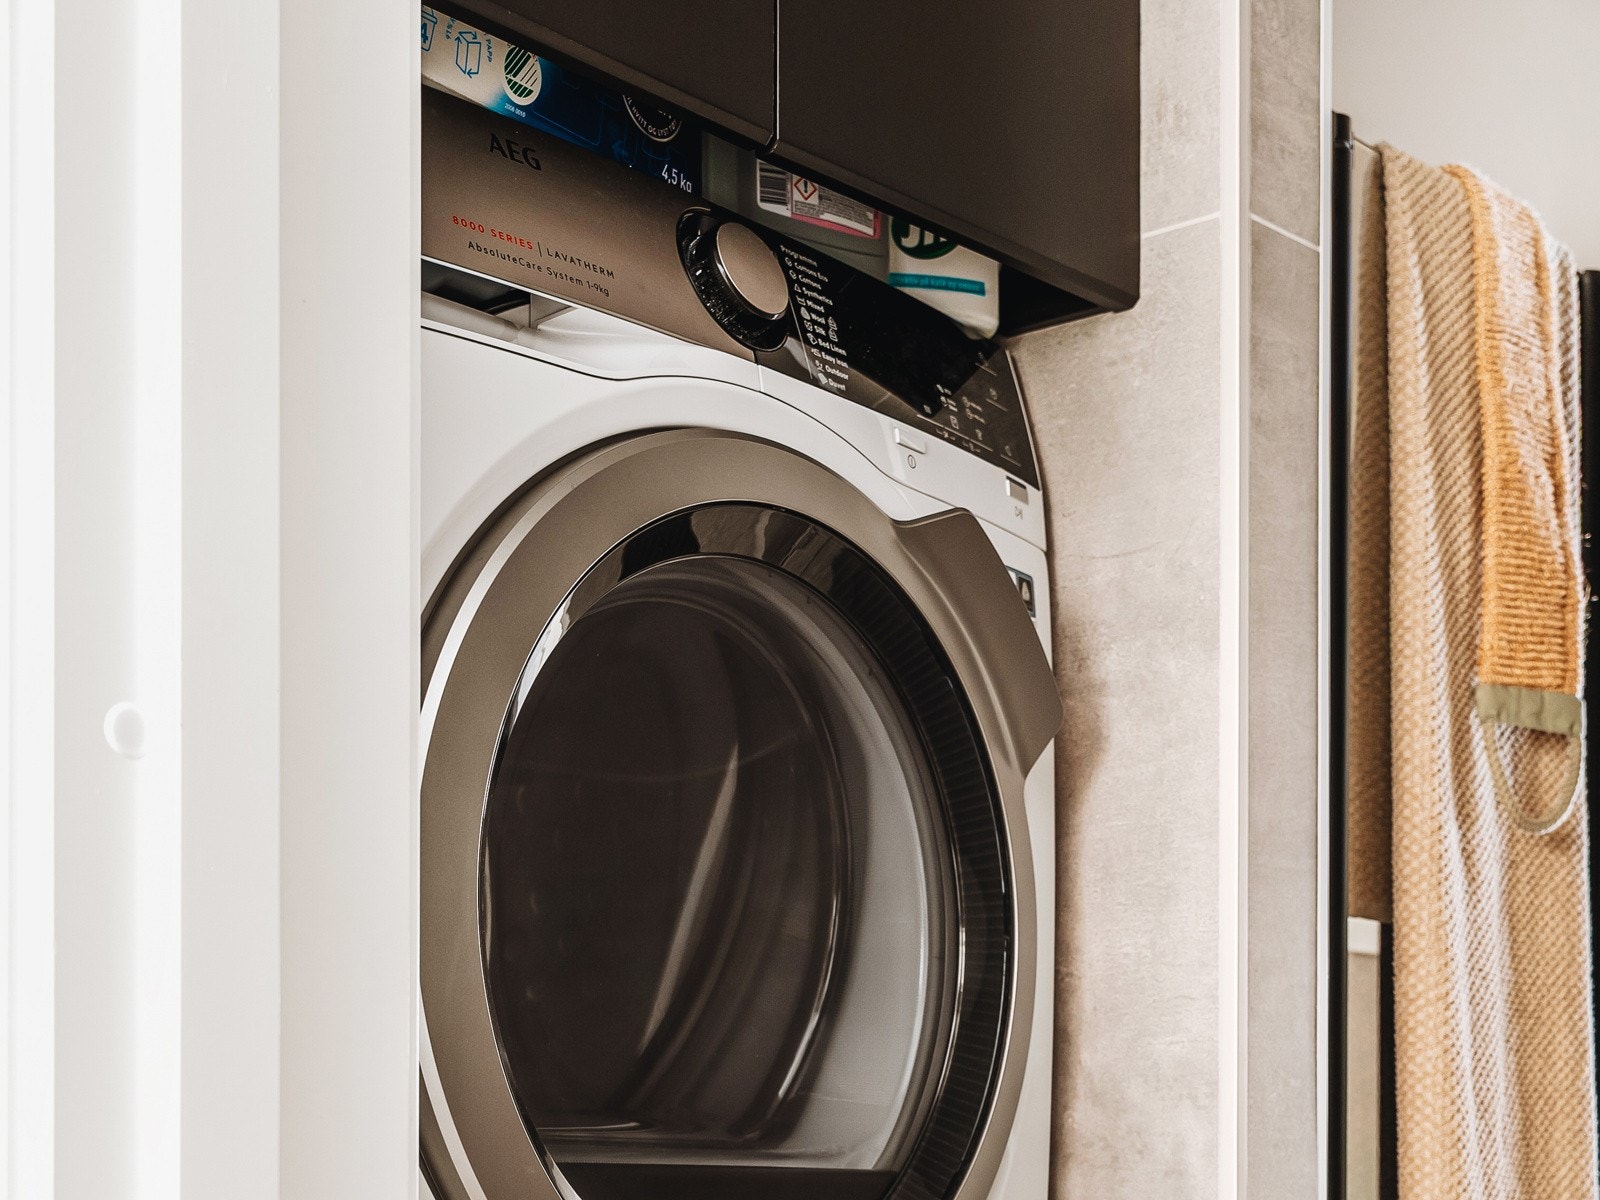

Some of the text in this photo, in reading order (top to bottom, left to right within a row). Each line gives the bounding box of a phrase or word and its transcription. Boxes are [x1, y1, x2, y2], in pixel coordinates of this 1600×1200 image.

[489, 133, 542, 171] AEG
[452, 215, 615, 279] 8000 SERIES LAVATHERM
[468, 240, 610, 297] AbsoluteCare System 1-9kg
[795, 262, 818, 278] Cottons
[799, 274, 822, 290] Cottons
[802, 287, 833, 306] Synthetics
[806, 300, 825, 313] Mixed
[810, 312, 826, 325] Wool
[814, 325, 827, 336] Silk
[817, 338, 847, 356] Bed Linen
[821, 351, 849, 368] Easy Iron
[825, 364, 849, 380] Outdoor
[828, 378, 846, 391] Duvet
